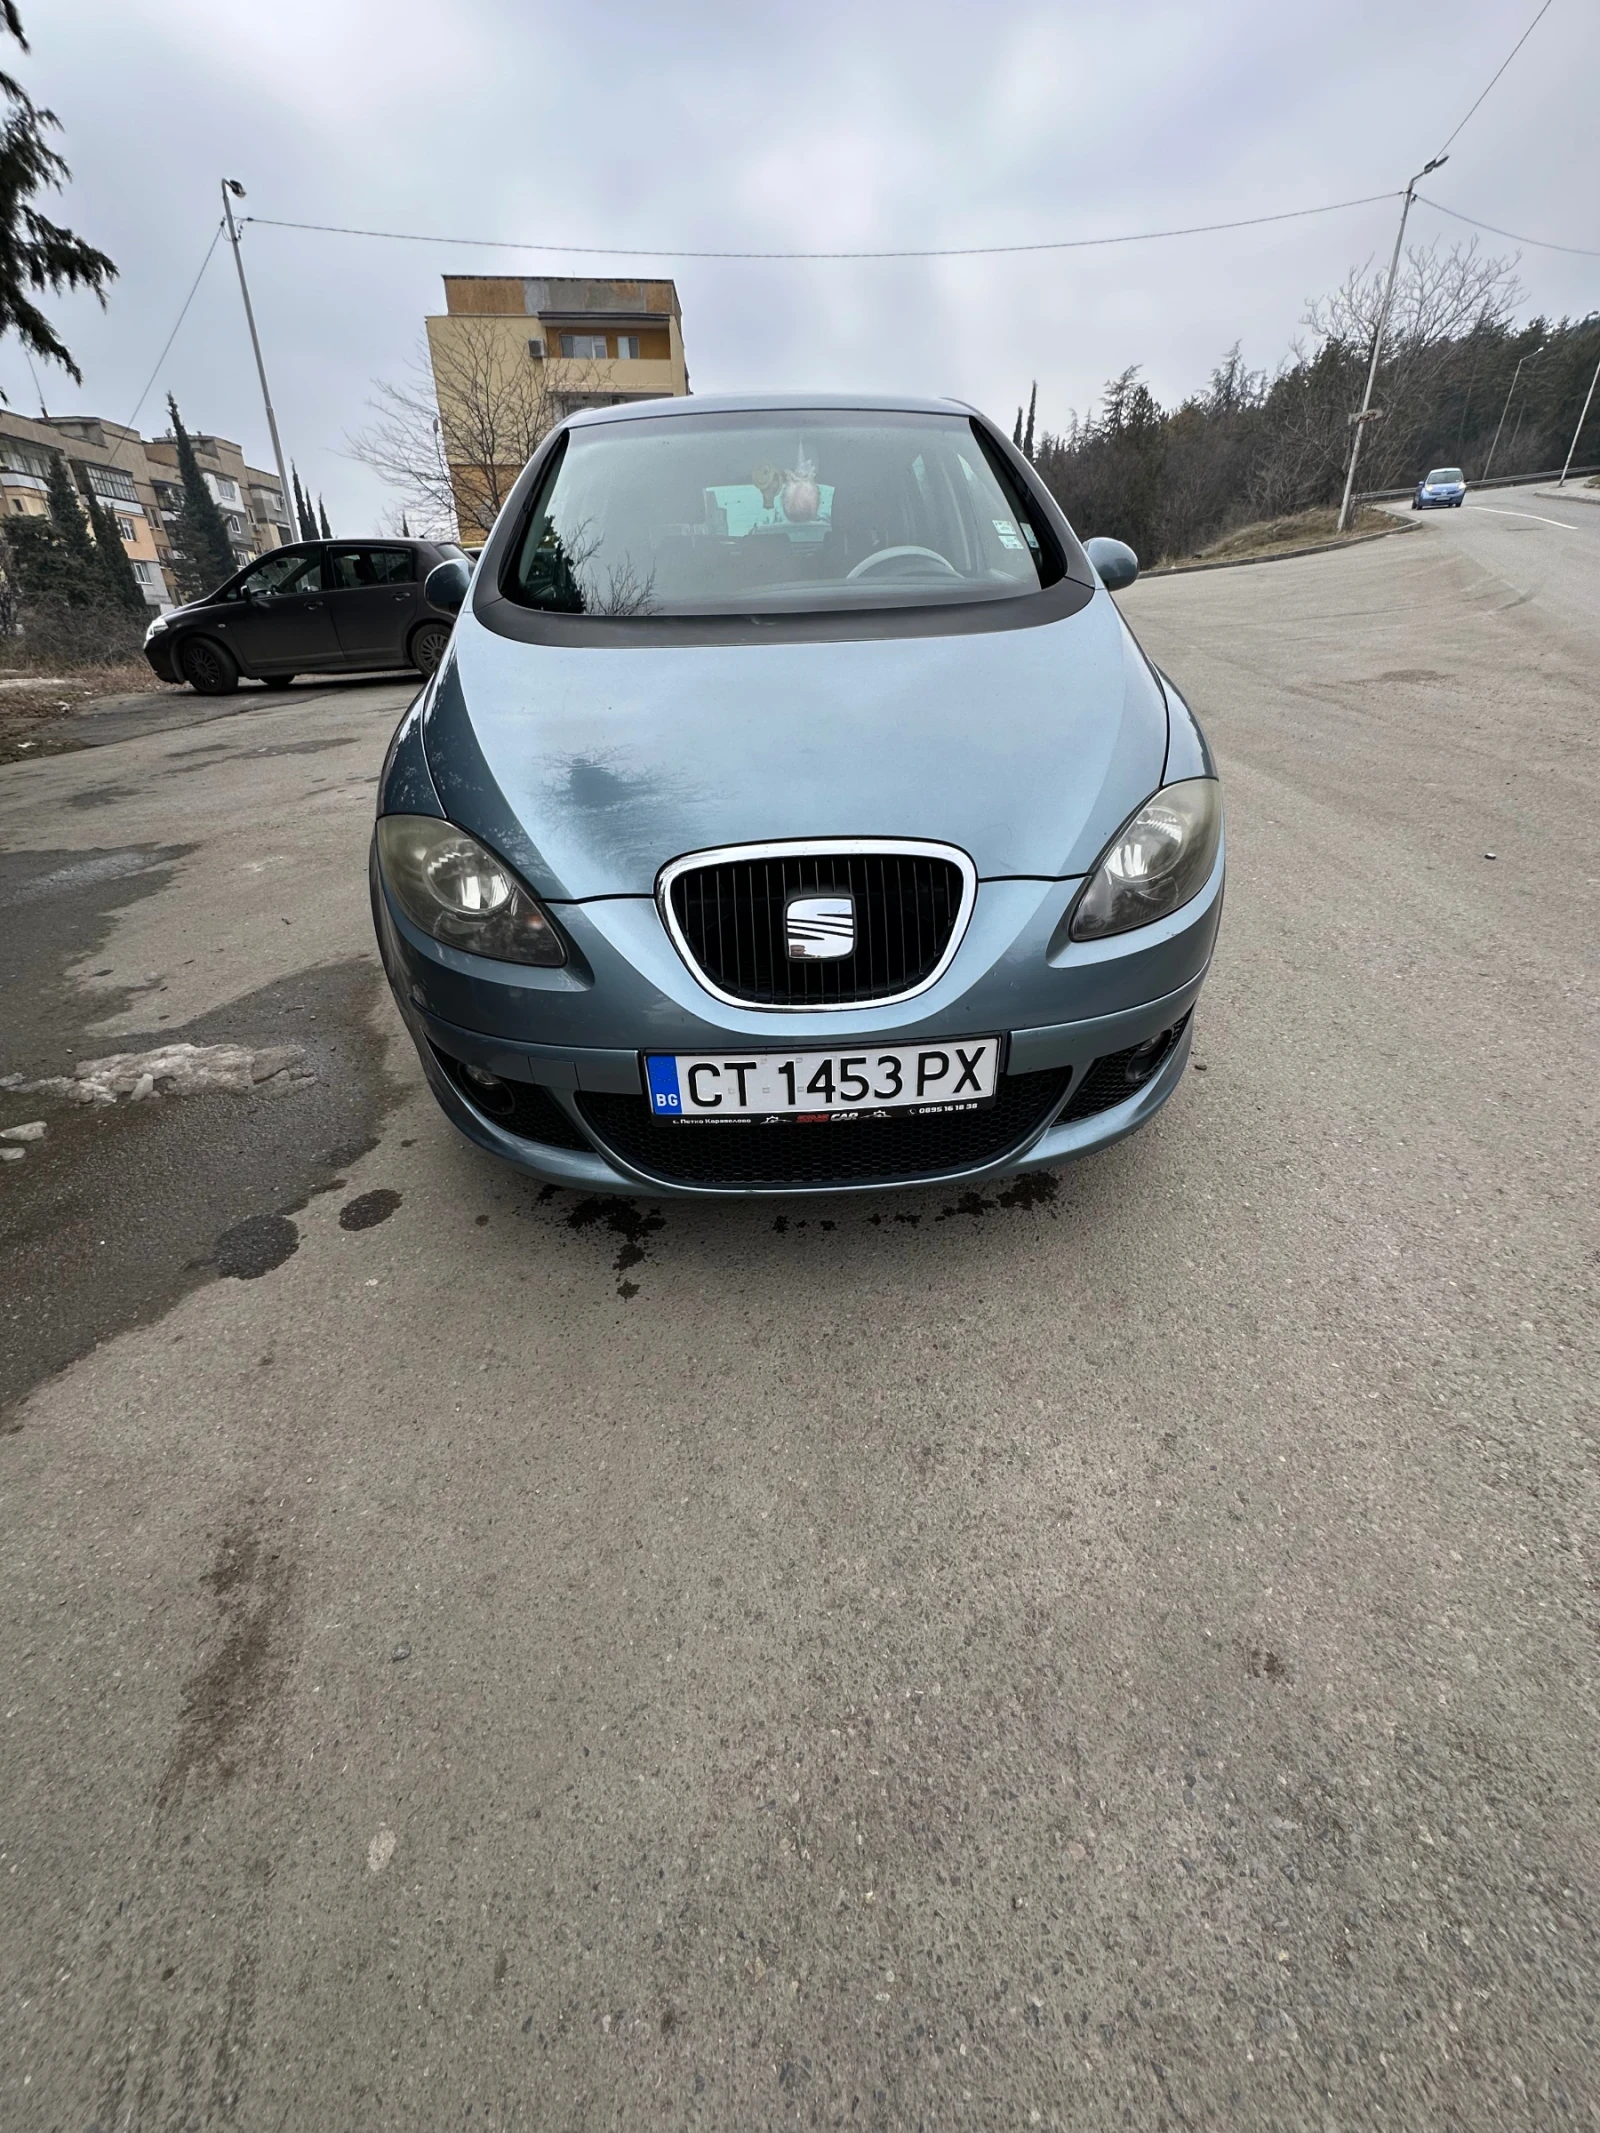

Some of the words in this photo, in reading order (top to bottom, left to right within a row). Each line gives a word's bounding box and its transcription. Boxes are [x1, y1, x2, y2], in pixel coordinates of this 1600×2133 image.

[687, 1060, 757, 1107] CT
[777, 1056, 903, 1105] 1453
[916, 1046, 987, 1097] PX
[655, 1093, 679, 1107] BG
[830, 1112, 859, 1122] CAR
